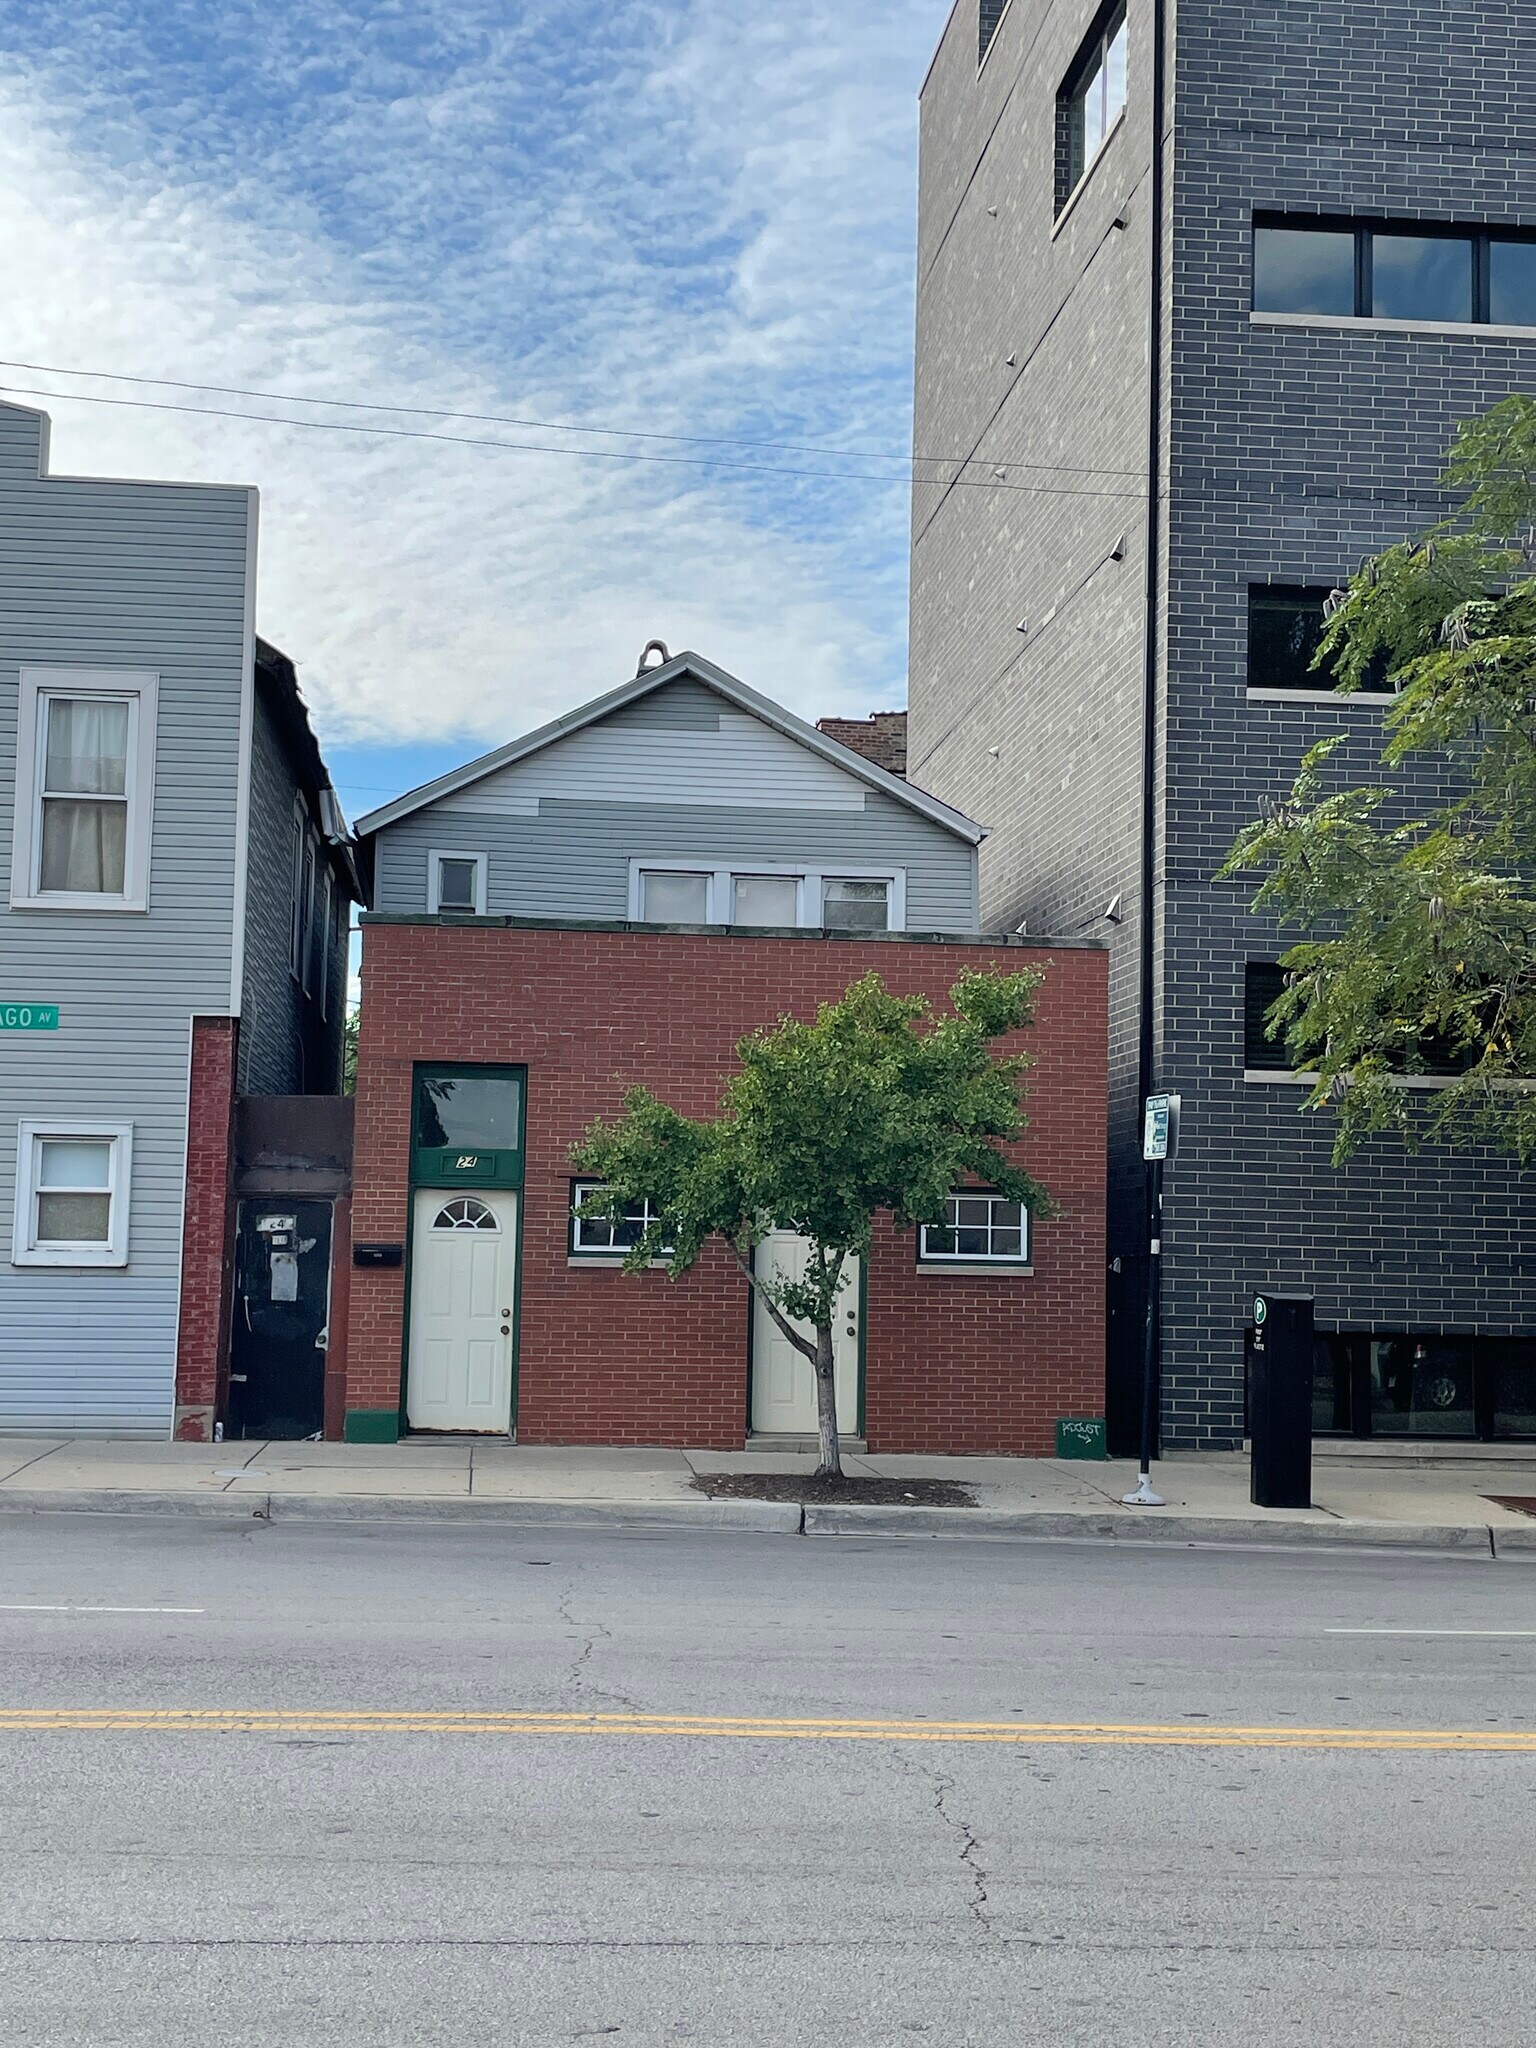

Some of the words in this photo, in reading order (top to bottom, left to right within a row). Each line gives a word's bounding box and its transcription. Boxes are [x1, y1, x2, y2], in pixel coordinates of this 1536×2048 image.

[38, 1012, 52, 1023] AV
[457, 1156, 477, 1168] 24
[1256, 1301, 1263, 1320] P
